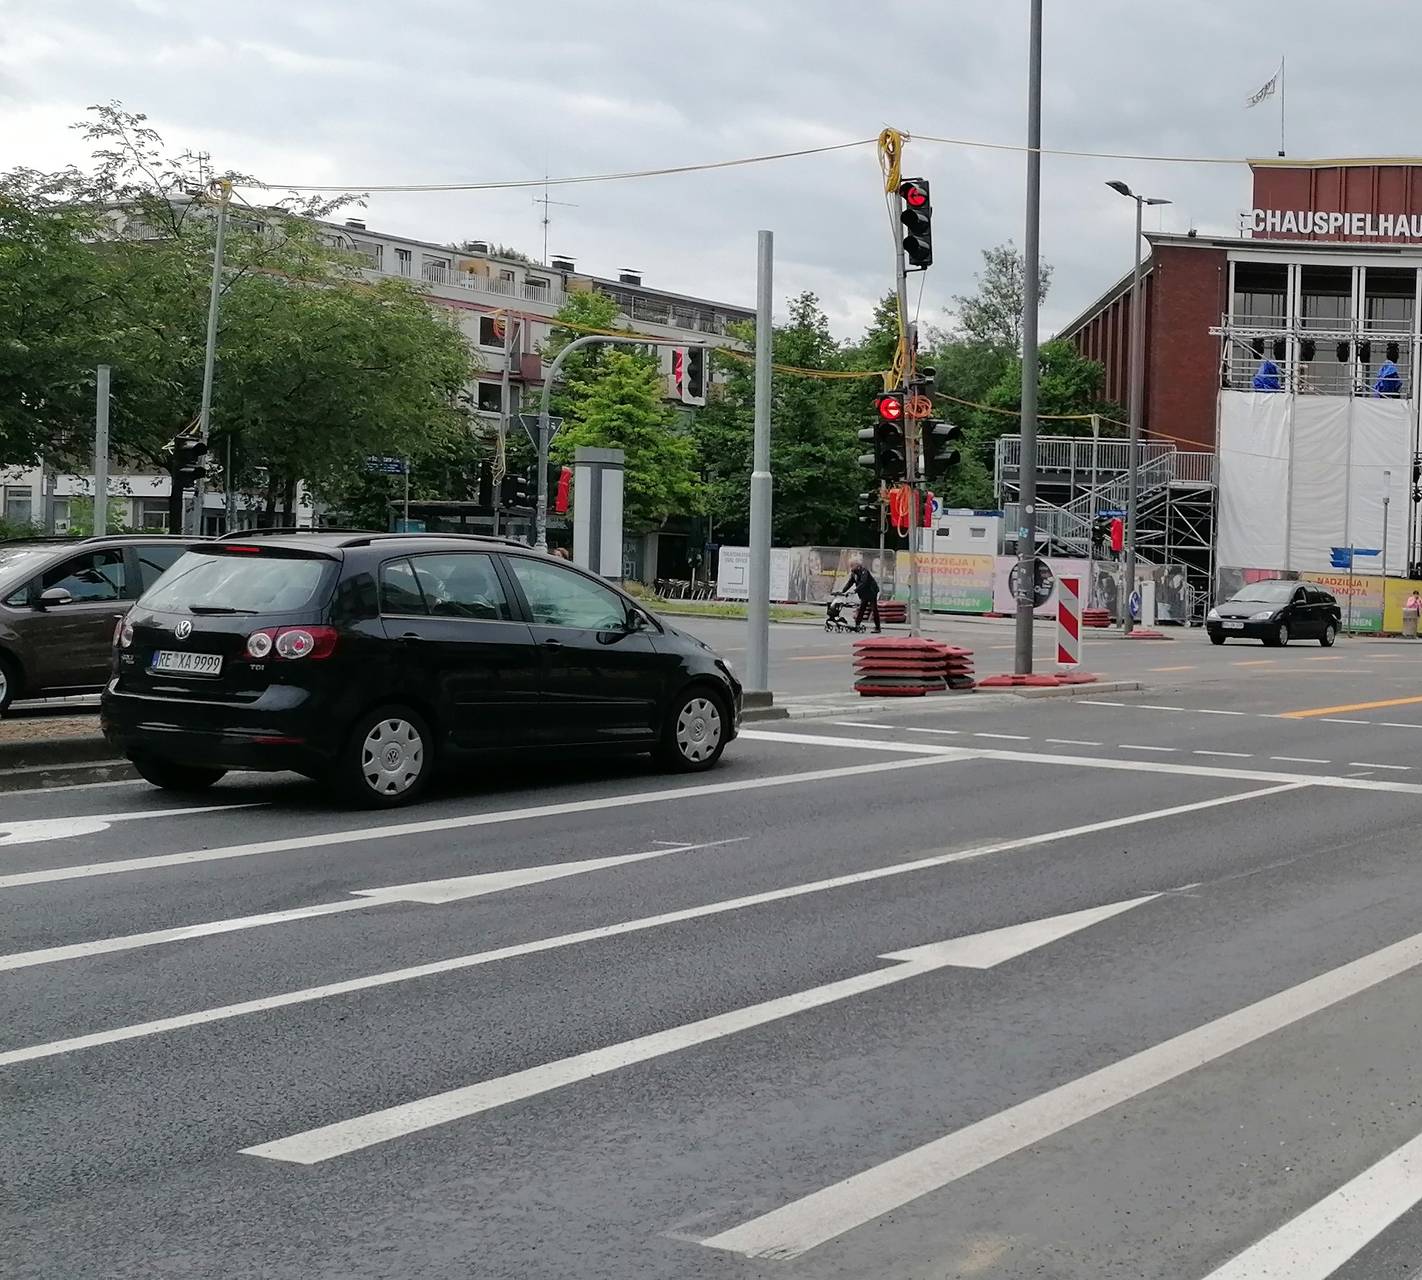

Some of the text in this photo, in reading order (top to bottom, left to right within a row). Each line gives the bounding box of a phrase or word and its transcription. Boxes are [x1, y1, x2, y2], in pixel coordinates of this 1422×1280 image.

[158, 652, 220, 671] RE XA 9999
